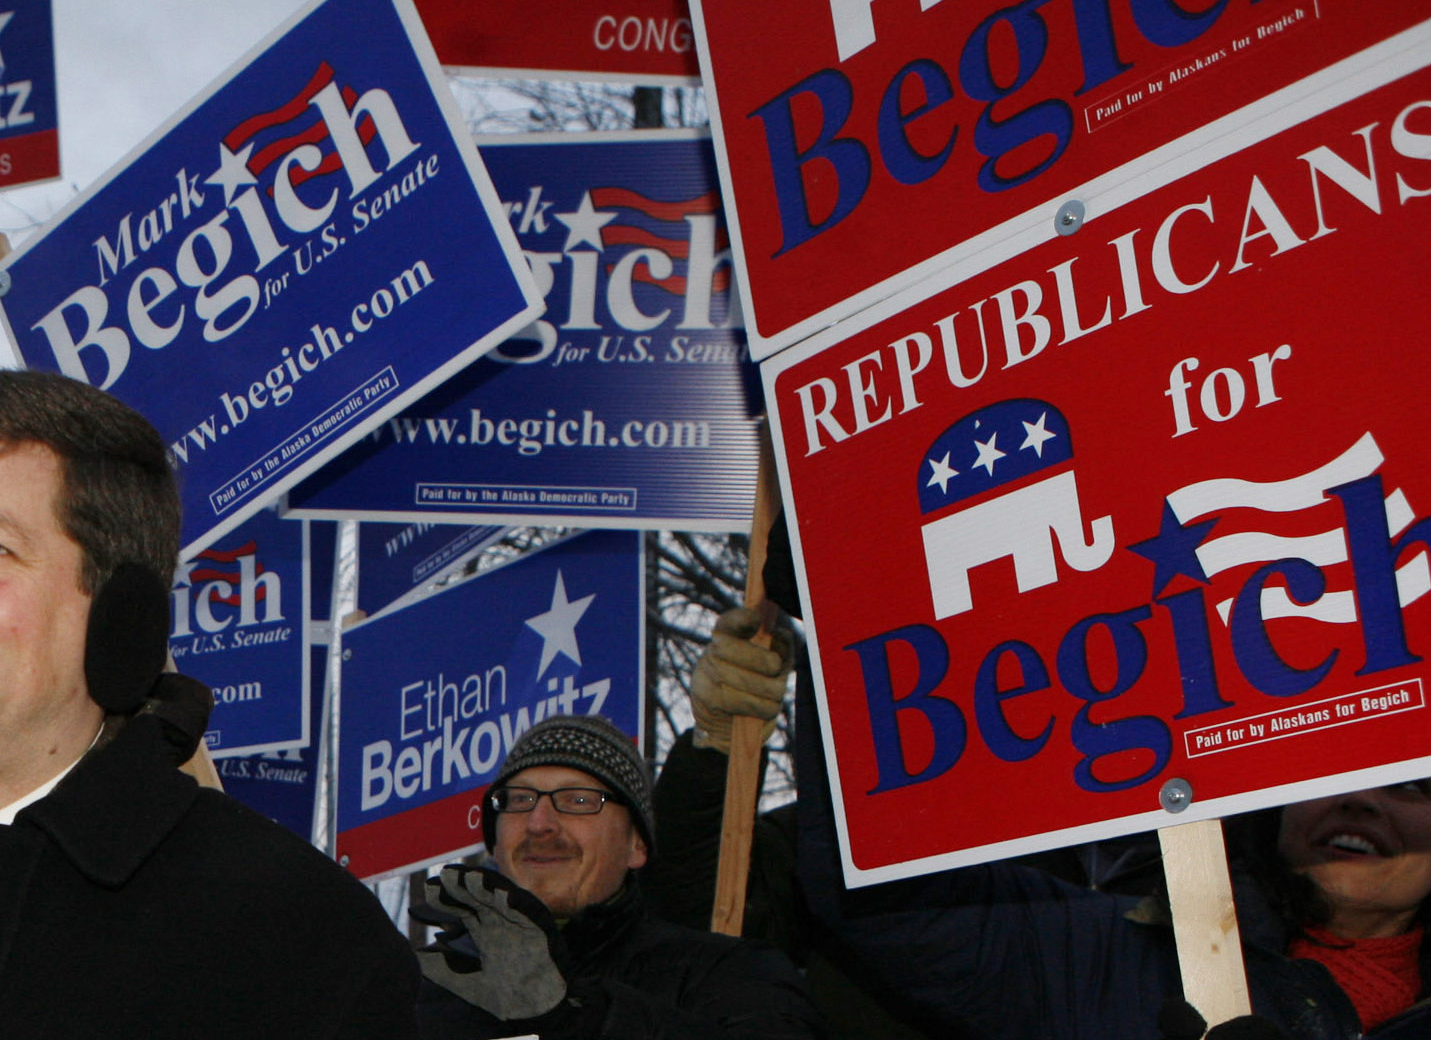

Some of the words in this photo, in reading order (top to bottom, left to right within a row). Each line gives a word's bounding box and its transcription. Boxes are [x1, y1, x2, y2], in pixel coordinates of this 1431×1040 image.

[593, 15, 692, 54] CONG
[1096, 99, 1122, 121] Paid
[1126, 91, 1142, 105] for
[1148, 80, 1163, 93] by
[1169, 48, 1227, 84] Alaskans
[1232, 36, 1251, 51] for
[1257, 8, 1305, 39] Begich
[746, 0, 1259, 259] Begi
[30, 83, 421, 392] Begich
[91, 166, 210, 287] Mark
[263, 272, 292, 309] for
[296, 223, 349, 276] U.S.
[349, 153, 441, 230] Senate
[552, 342, 590, 367] for
[597, 336, 655, 363] U.S.
[1165, 344, 1291, 438] for
[216, 485, 236, 506] Paid
[237, 478, 250, 492] for
[251, 470, 263, 482] by
[264, 457, 280, 471] the
[281, 435, 312, 460] Alaska
[311, 395, 363, 437] Democratic
[364, 376, 391, 400] Party
[422, 488, 444, 499] Paid
[447, 489, 462, 500] for
[465, 489, 477, 502] by
[482, 489, 498, 501] the
[502, 489, 536, 502] Alaska
[539, 491, 598, 504] Democratic
[601, 492, 629, 506] Party
[192, 633, 225, 655] U.S.
[231, 627, 291, 649] Senate
[401, 665, 506, 742] Ethan
[1196, 731, 1222, 749] Paid
[1227, 727, 1244, 742] for
[1250, 723, 1265, 737] by
[1271, 711, 1330, 732] Alaskans
[1336, 702, 1355, 718] for
[1362, 690, 1409, 713] Begich
[221, 760, 251, 778] U.S.
[256, 761, 308, 784] Senate
